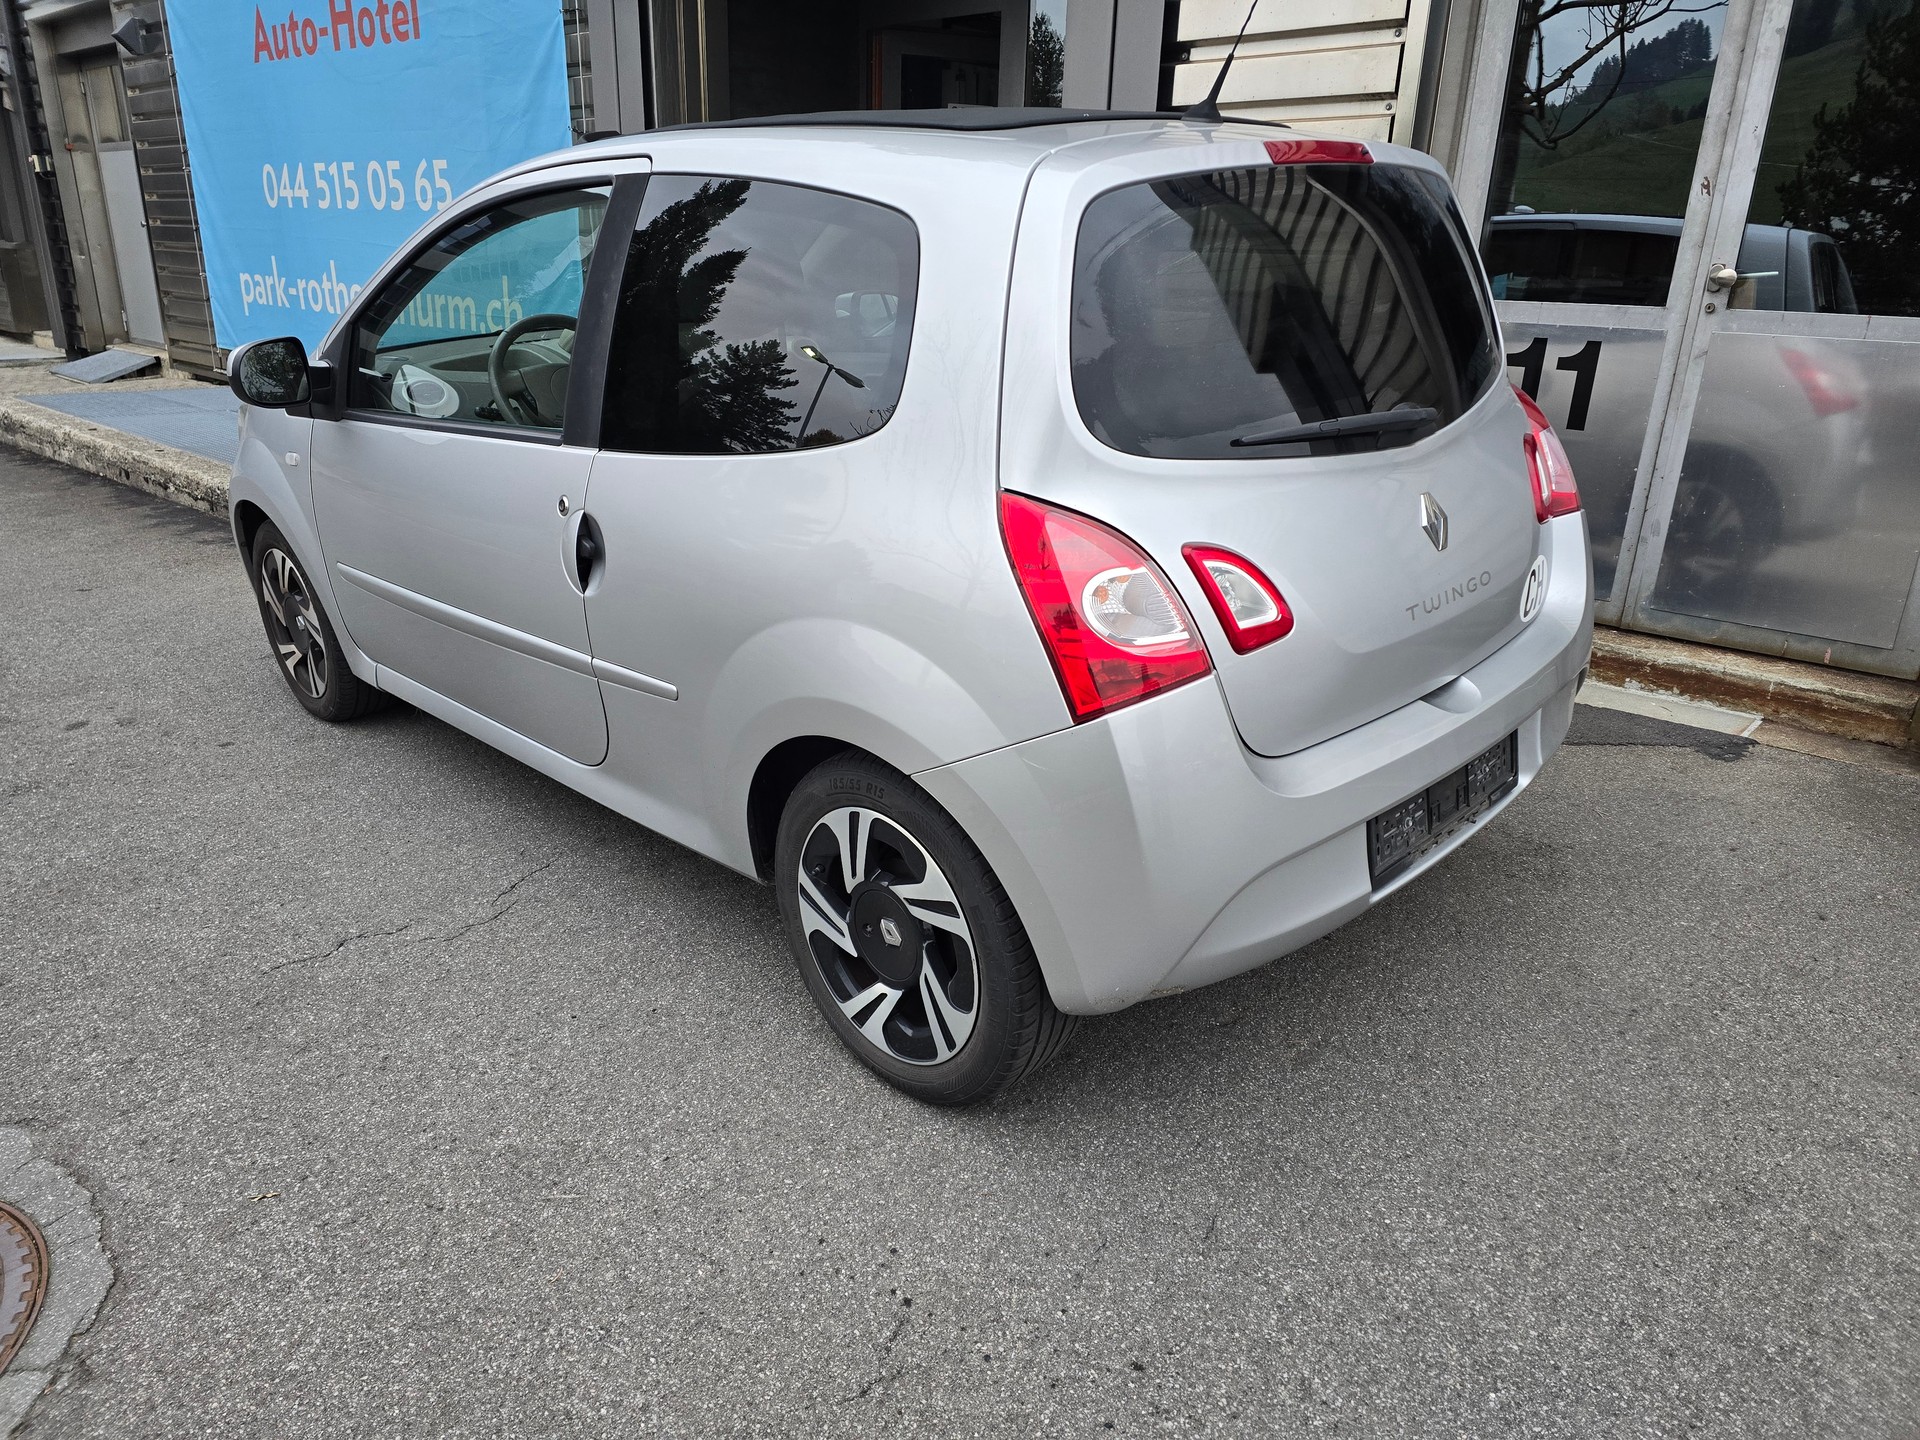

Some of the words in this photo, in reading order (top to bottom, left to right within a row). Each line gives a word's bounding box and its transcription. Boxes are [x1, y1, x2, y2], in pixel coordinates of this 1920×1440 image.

[254, 0, 420, 63] Auto-Hotel
[262, 163, 309, 209] 044
[313, 161, 360, 210] 515
[366, 160, 405, 211] 05
[414, 158, 452, 212] 65
[1506, 337, 1602, 431] 11
[1405, 571, 1491, 621] TWINGO
[1523, 559, 1545, 618] CH
[829, 777, 861, 791] 185/55
[865, 782, 885, 800] R15
